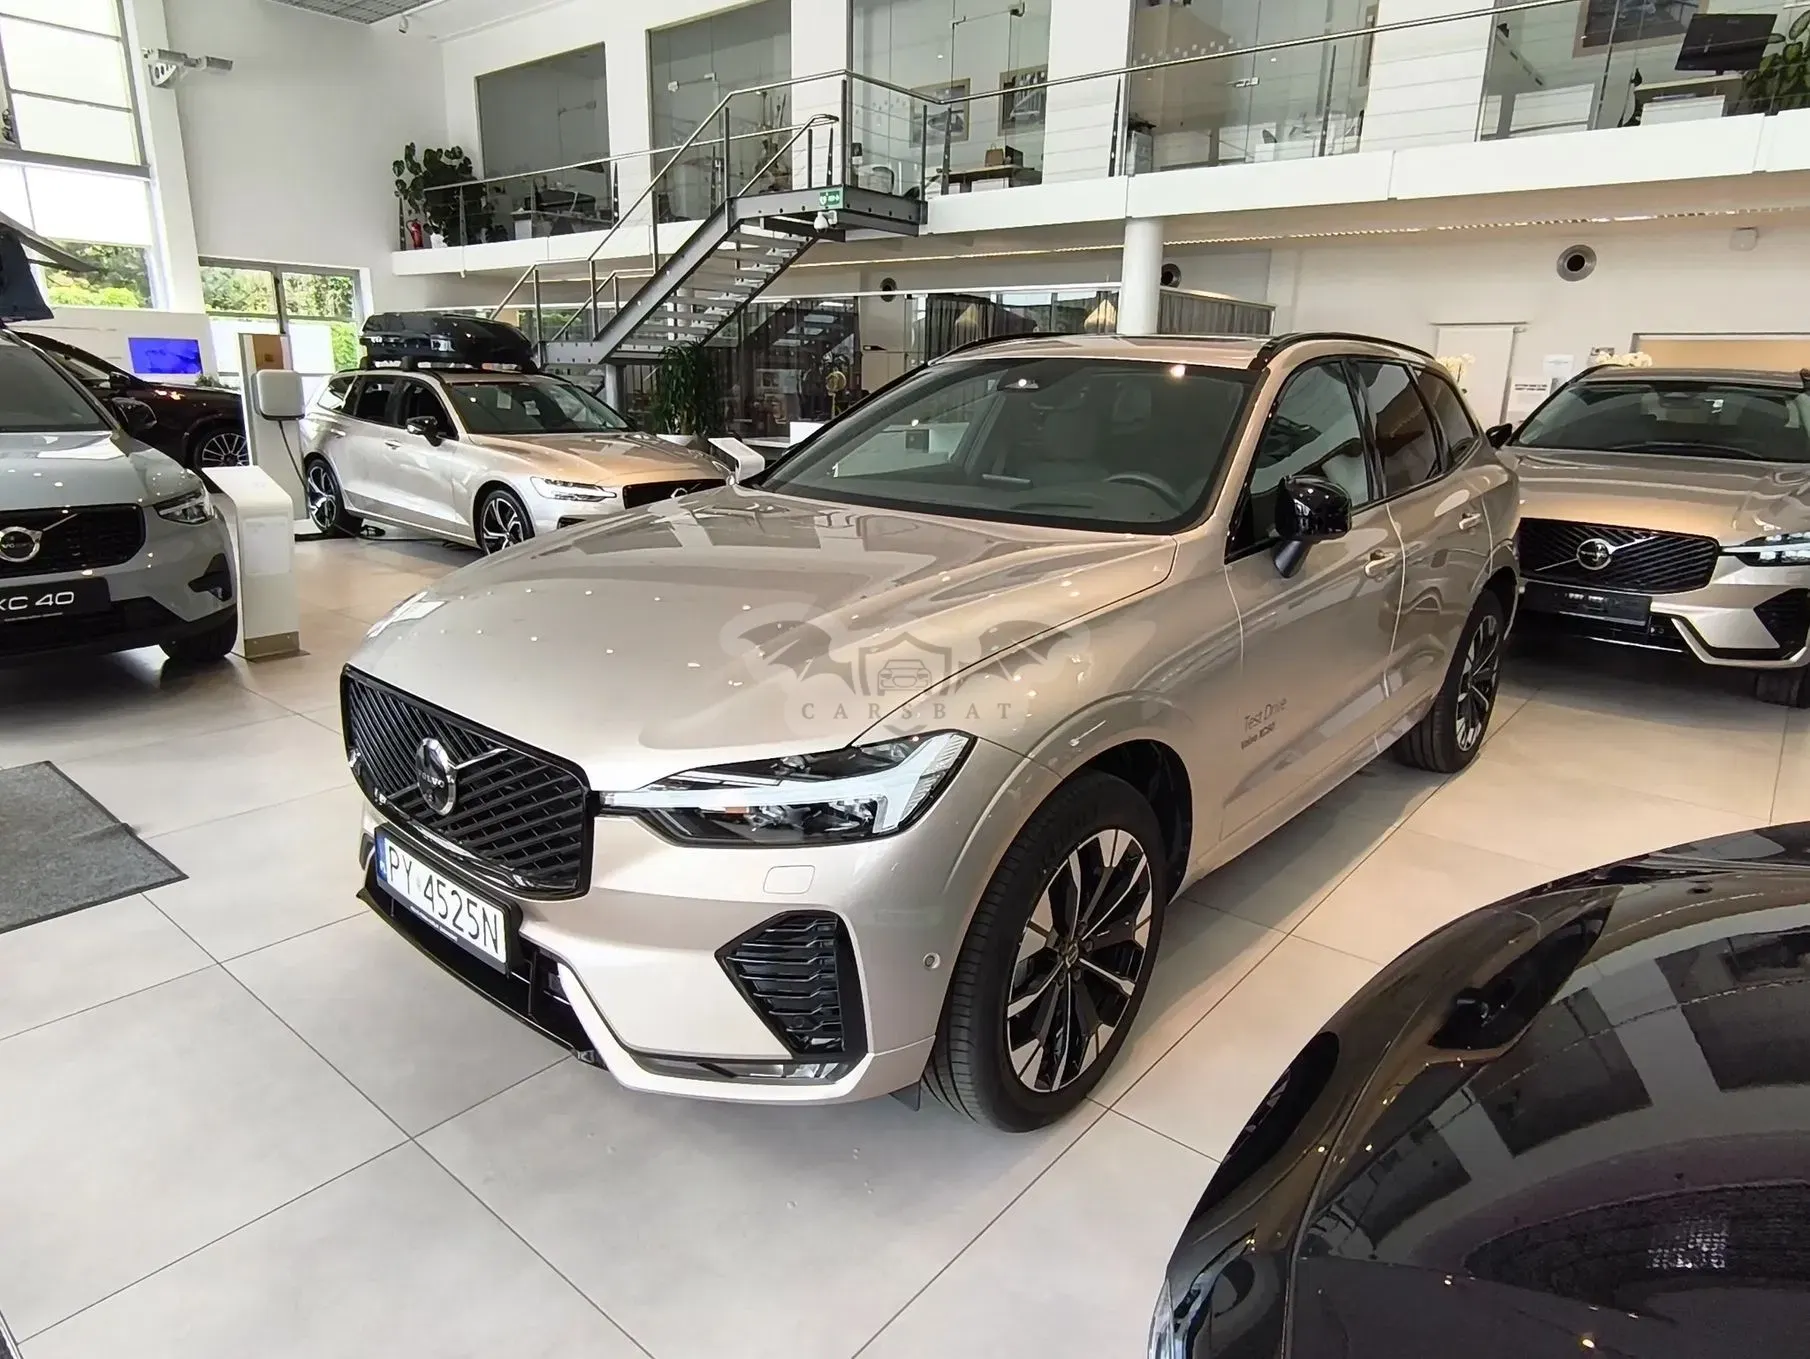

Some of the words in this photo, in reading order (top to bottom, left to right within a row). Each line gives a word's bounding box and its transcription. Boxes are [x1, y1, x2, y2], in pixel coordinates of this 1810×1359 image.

[35, 590, 75, 606] 40
[388, 845, 413, 895] PY
[423, 873, 499, 955] 4525N
